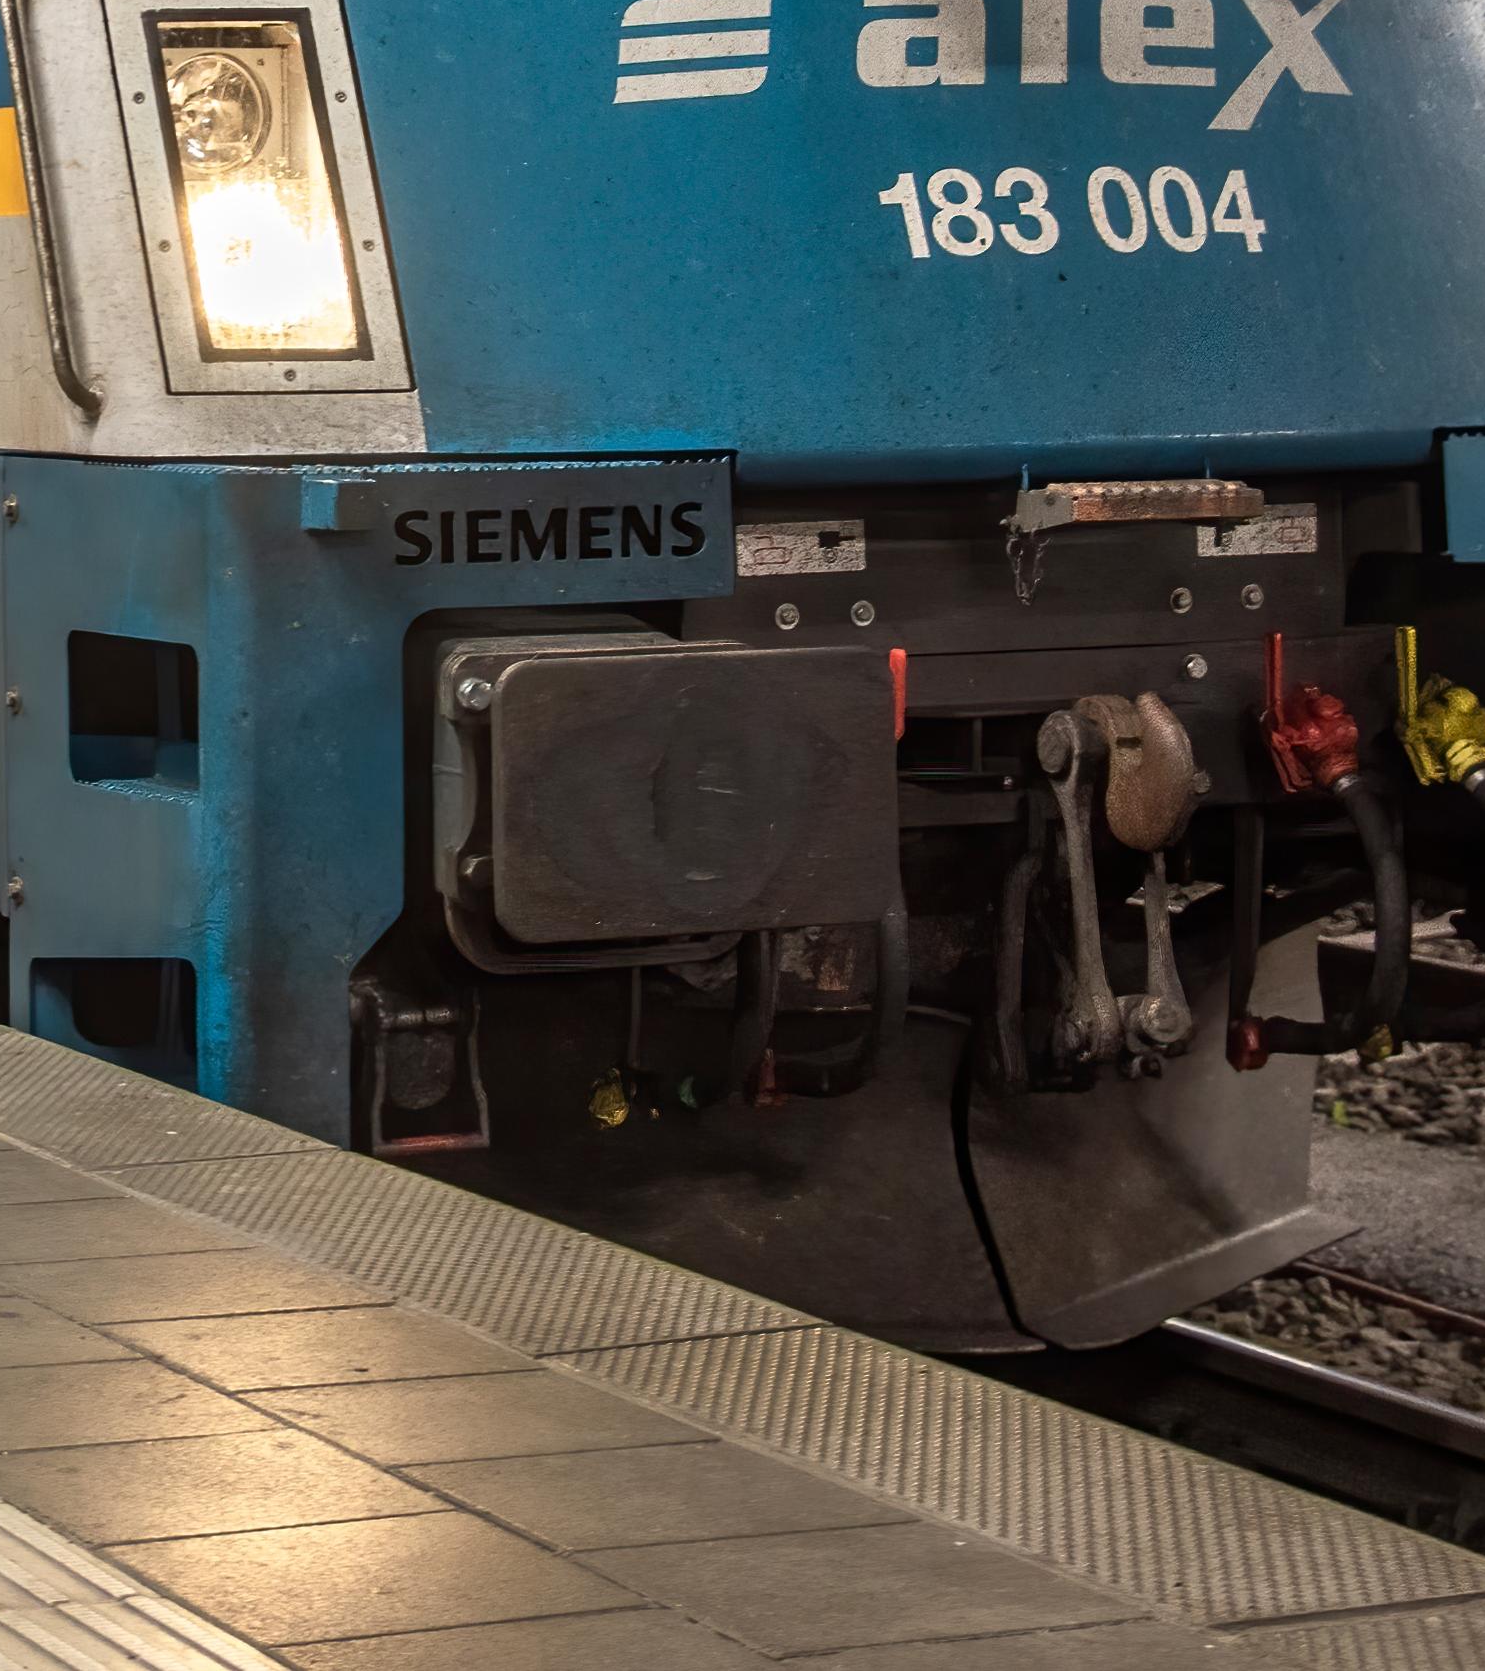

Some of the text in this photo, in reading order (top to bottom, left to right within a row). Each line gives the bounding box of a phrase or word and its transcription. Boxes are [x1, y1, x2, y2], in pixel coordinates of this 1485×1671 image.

[878, 165, 1267, 259] 183 004
[392, 501, 706, 566] SIEMENS
